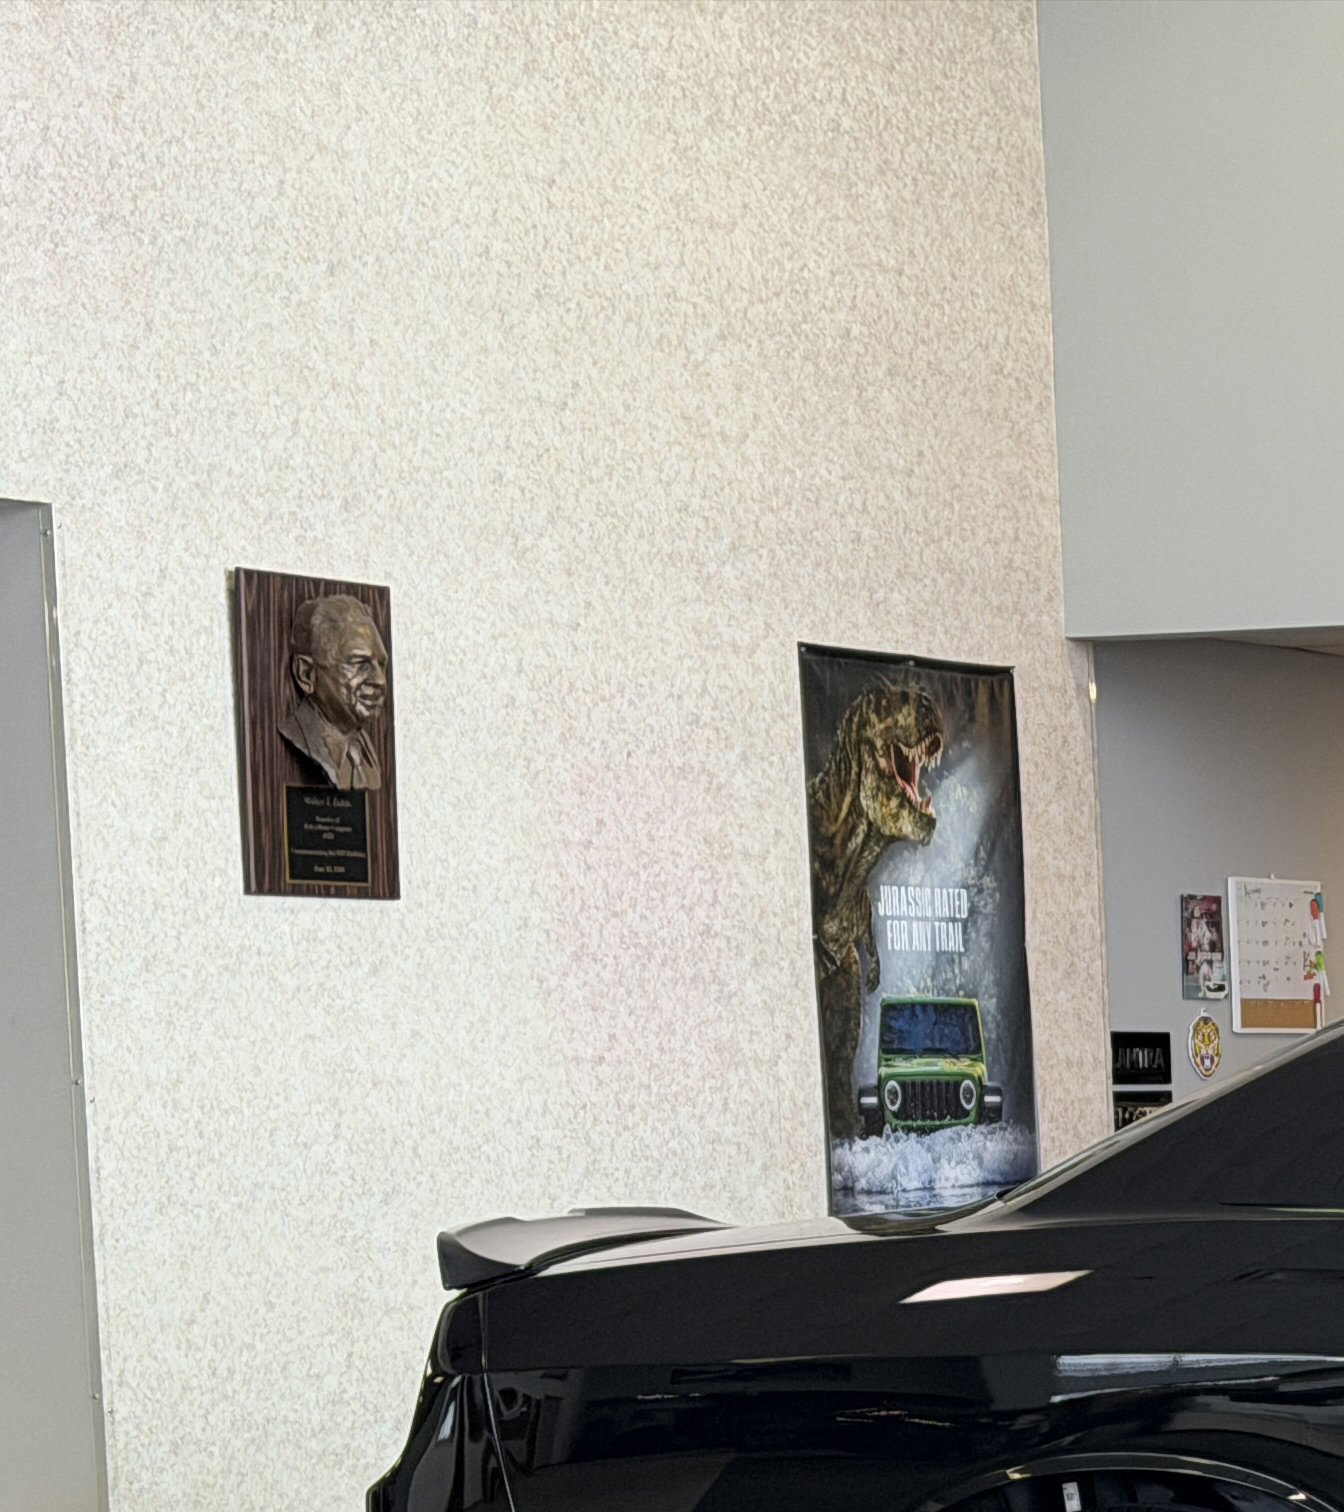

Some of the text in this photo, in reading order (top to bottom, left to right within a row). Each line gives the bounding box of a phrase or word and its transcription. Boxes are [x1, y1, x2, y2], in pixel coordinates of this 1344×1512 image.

[877, 884, 968, 919] JURASSIC RATED
[886, 919, 965, 953] FOR ANY TRAIL
